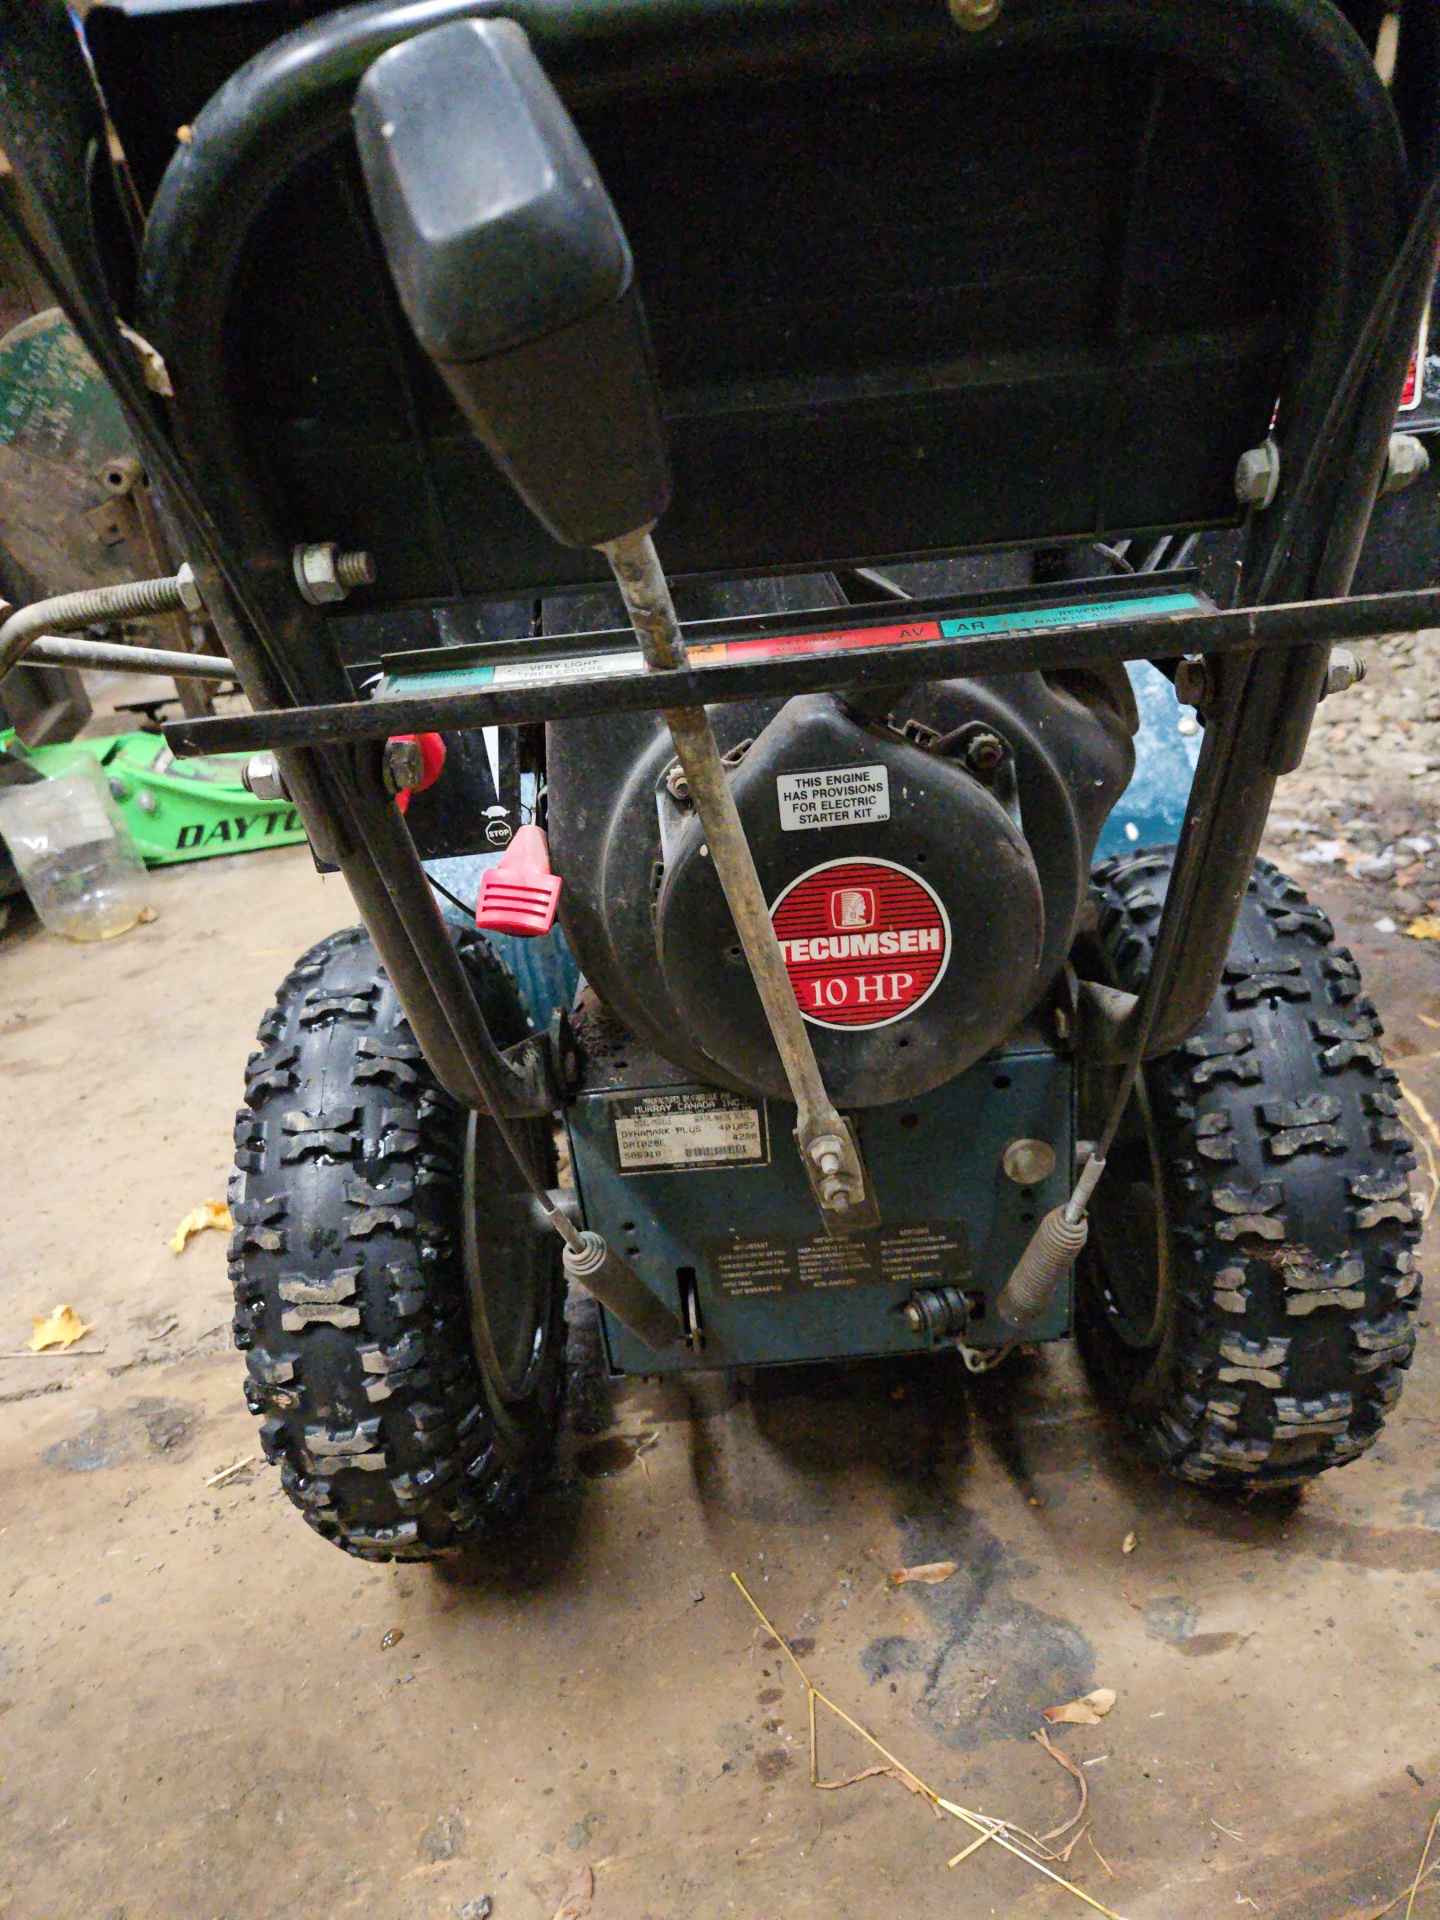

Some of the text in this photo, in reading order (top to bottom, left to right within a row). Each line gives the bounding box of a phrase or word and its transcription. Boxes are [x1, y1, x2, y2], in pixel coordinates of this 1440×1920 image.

[900, 627, 924, 639] AV
[956, 620, 986, 633] AR
[795, 771, 870, 788] THIS ENGINE
[784, 782, 883, 801] HAS PROVISIONS
[792, 795, 877, 813] FOR ELECTRIC
[799, 808, 872, 824] STARTER KIT
[489, 829, 509, 837] STOP
[778, 928, 941, 963] TECUMSEH
[811, 973, 913, 1007] 10 HP
[634, 1104, 672, 1114] MURRAY
[677, 1102, 716, 1111] CANADA
